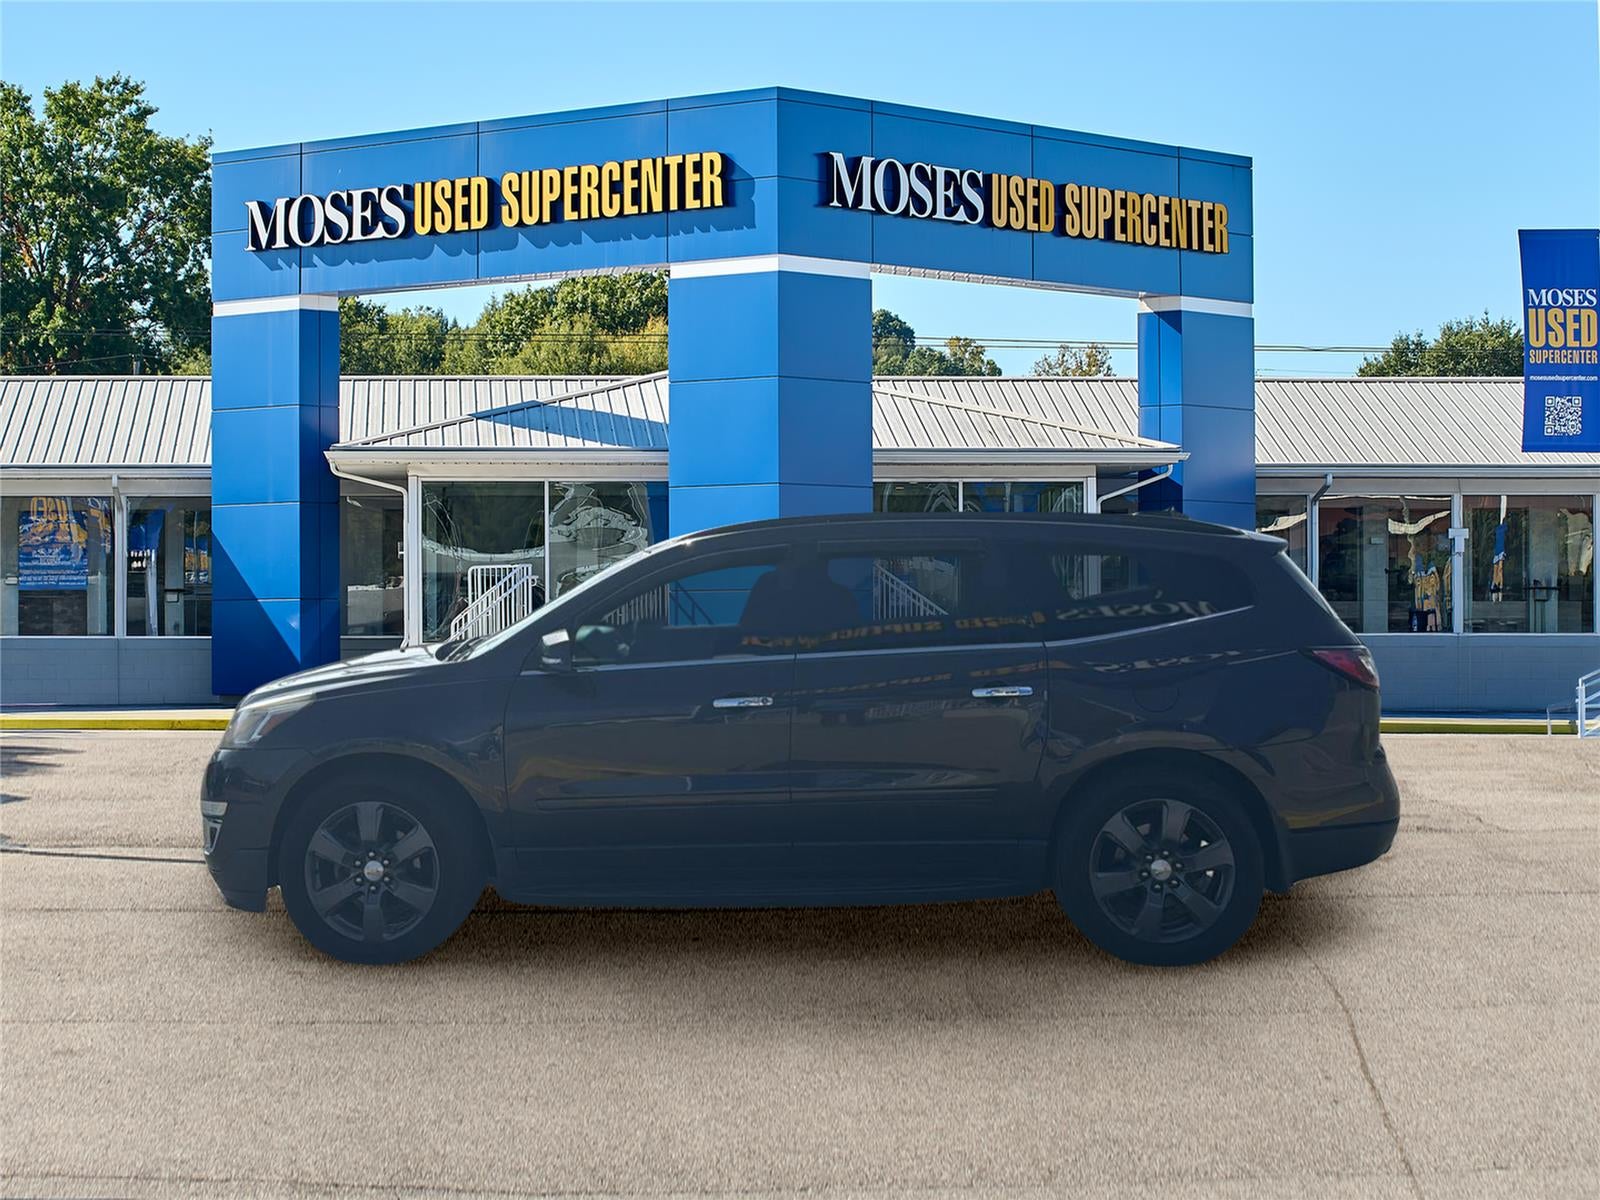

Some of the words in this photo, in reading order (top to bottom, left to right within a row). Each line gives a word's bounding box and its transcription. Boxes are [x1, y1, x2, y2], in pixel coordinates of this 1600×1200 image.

[244, 184, 407, 251] MOSES
[413, 176, 489, 236] USED
[501, 152, 724, 228] SUPERCENTER
[828, 151, 985, 225] MOSES
[991, 173, 1056, 232] USED
[1065, 183, 1229, 254] SUPERCENTER
[1527, 288, 1597, 307] MOSES
[1528, 308, 1598, 348] USED
[1529, 349, 1598, 364] SUPERCENTER
[1529, 374, 1599, 382] mosesusedsupercenter.com
